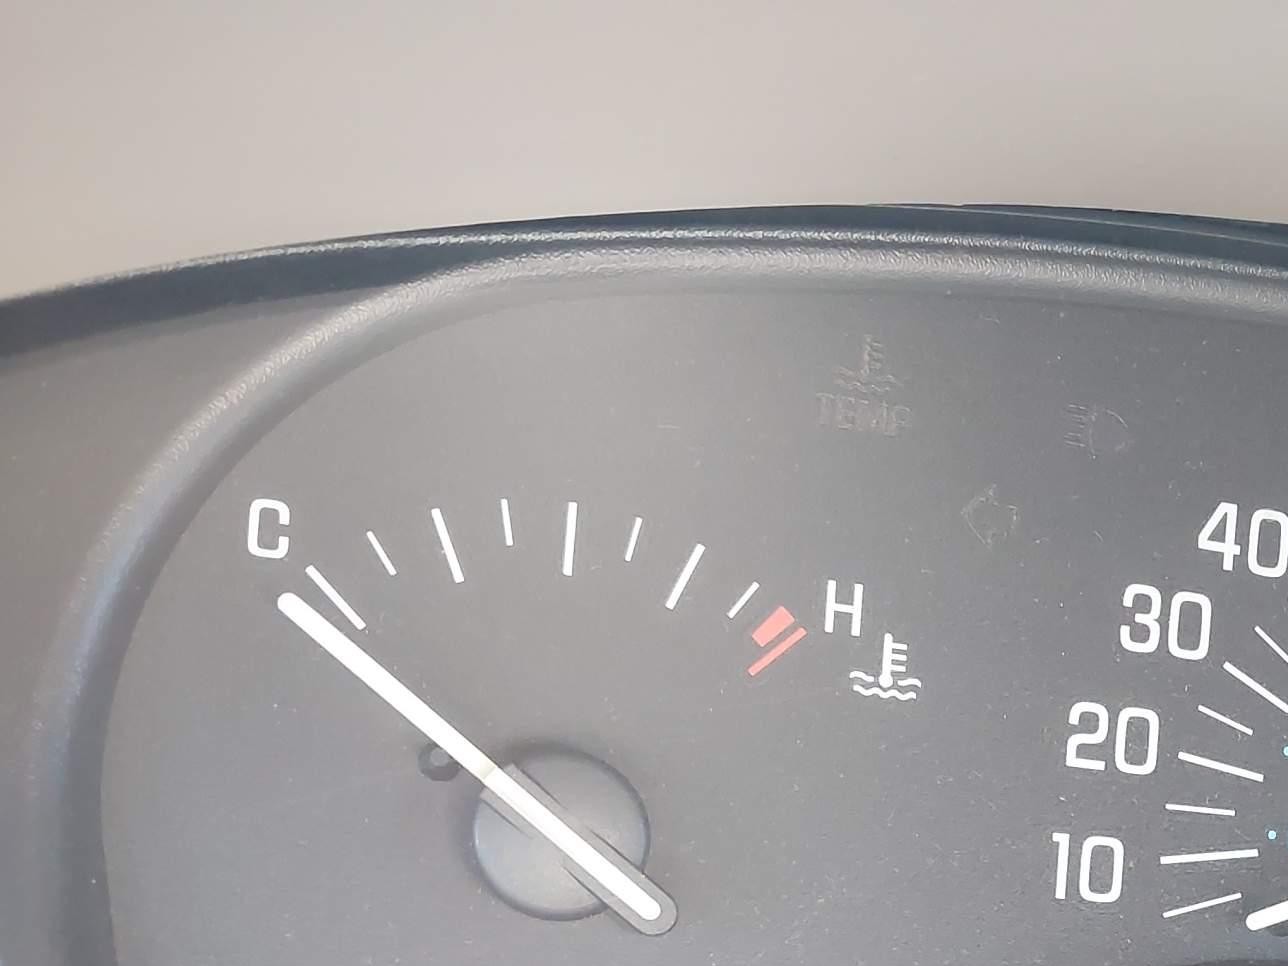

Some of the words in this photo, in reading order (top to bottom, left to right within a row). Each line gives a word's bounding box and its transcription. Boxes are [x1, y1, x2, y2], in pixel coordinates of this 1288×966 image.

[248, 499, 290, 558] C
[825, 580, 863, 636] H
[1120, 584, 1211, 660] 30
[1066, 702, 1159, 775] 20
[1053, 833, 1124, 902] 10
